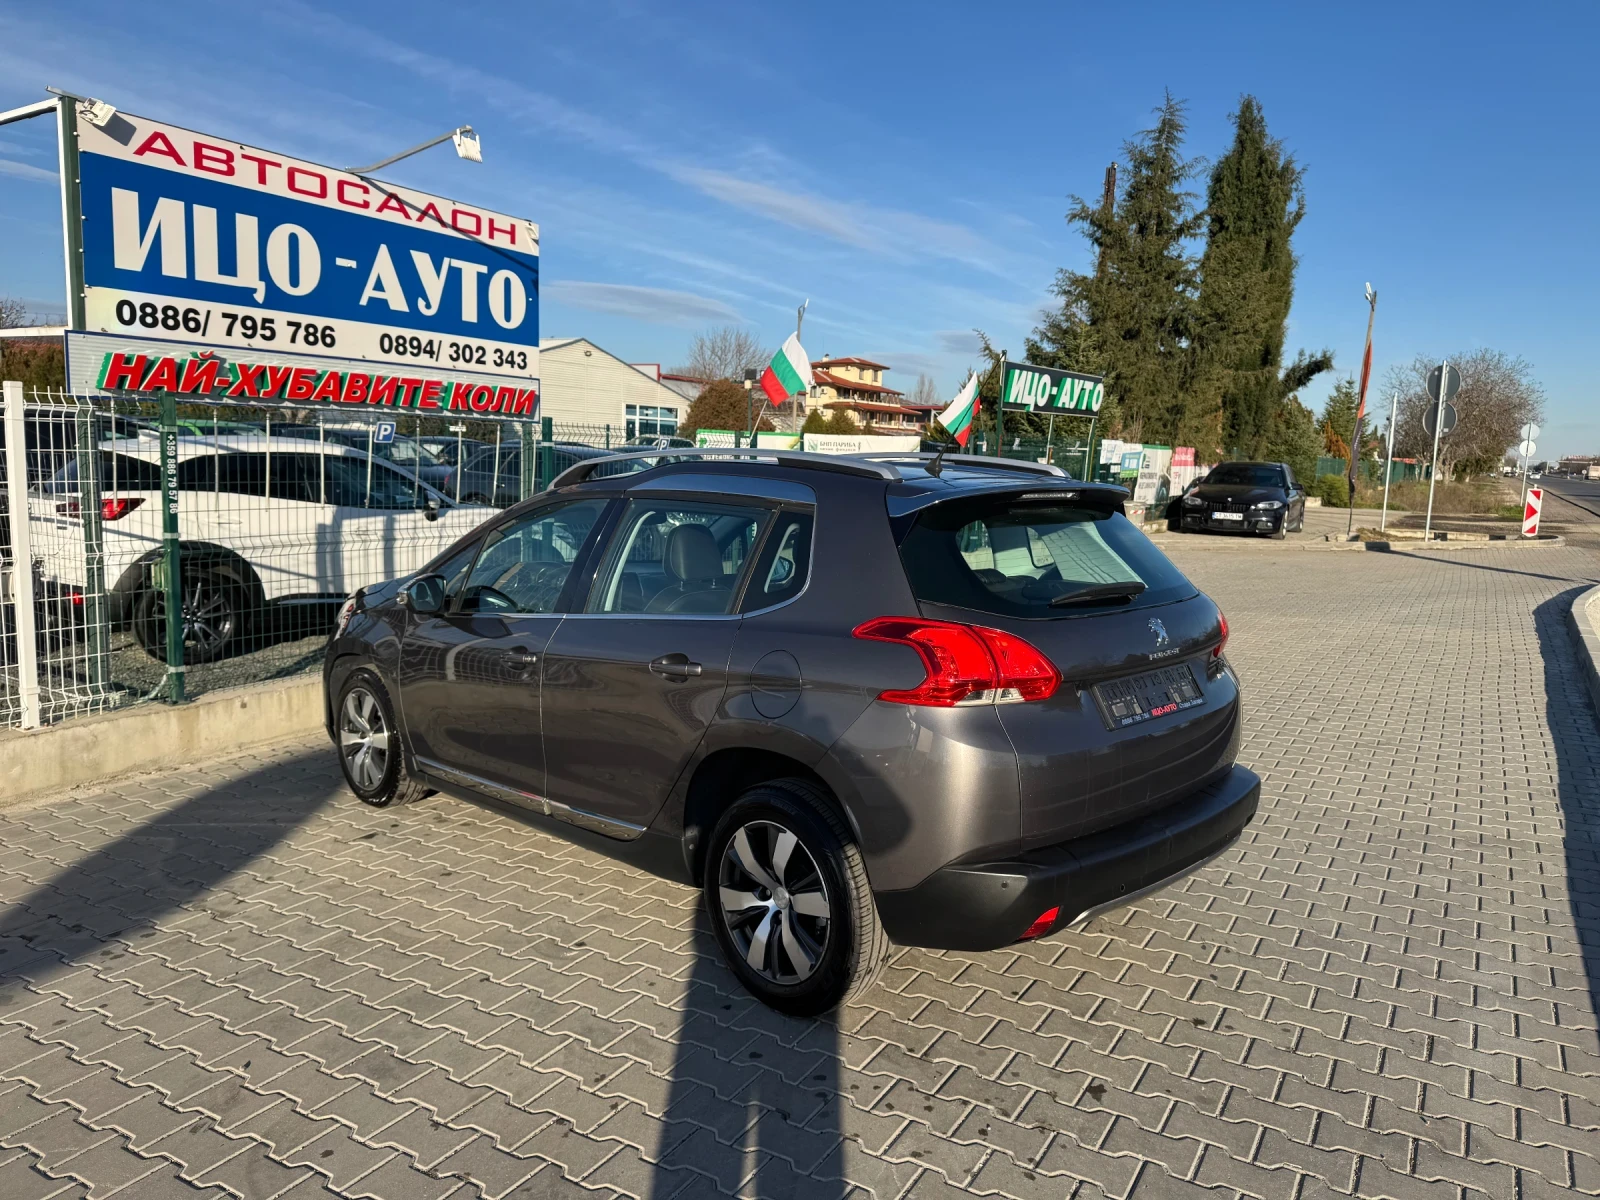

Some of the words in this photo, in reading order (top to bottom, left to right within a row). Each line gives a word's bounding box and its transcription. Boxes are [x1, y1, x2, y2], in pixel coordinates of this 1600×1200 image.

[133, 131, 517, 246] АВТОСАЛОН
[116, 299, 211, 337] 0886/
[221, 312, 276, 341] 795
[286, 321, 336, 348] 786
[379, 333, 442, 362] 0894/
[448, 342, 487, 365] 302
[493, 348, 528, 370] 343
[102, 350, 443, 409] НАЙ-ХУБАВИТЕ
[447, 382, 536, 415] КОЛИ
[1008, 369, 1104, 412] ИЦО-АУТО
[378, 424, 392, 440] P
[166, 434, 176, 456] +359
[167, 458, 176, 475] 886
[168, 476, 177, 488] 79
[168, 489, 178, 501] 57
[169, 502, 178, 514] 86
